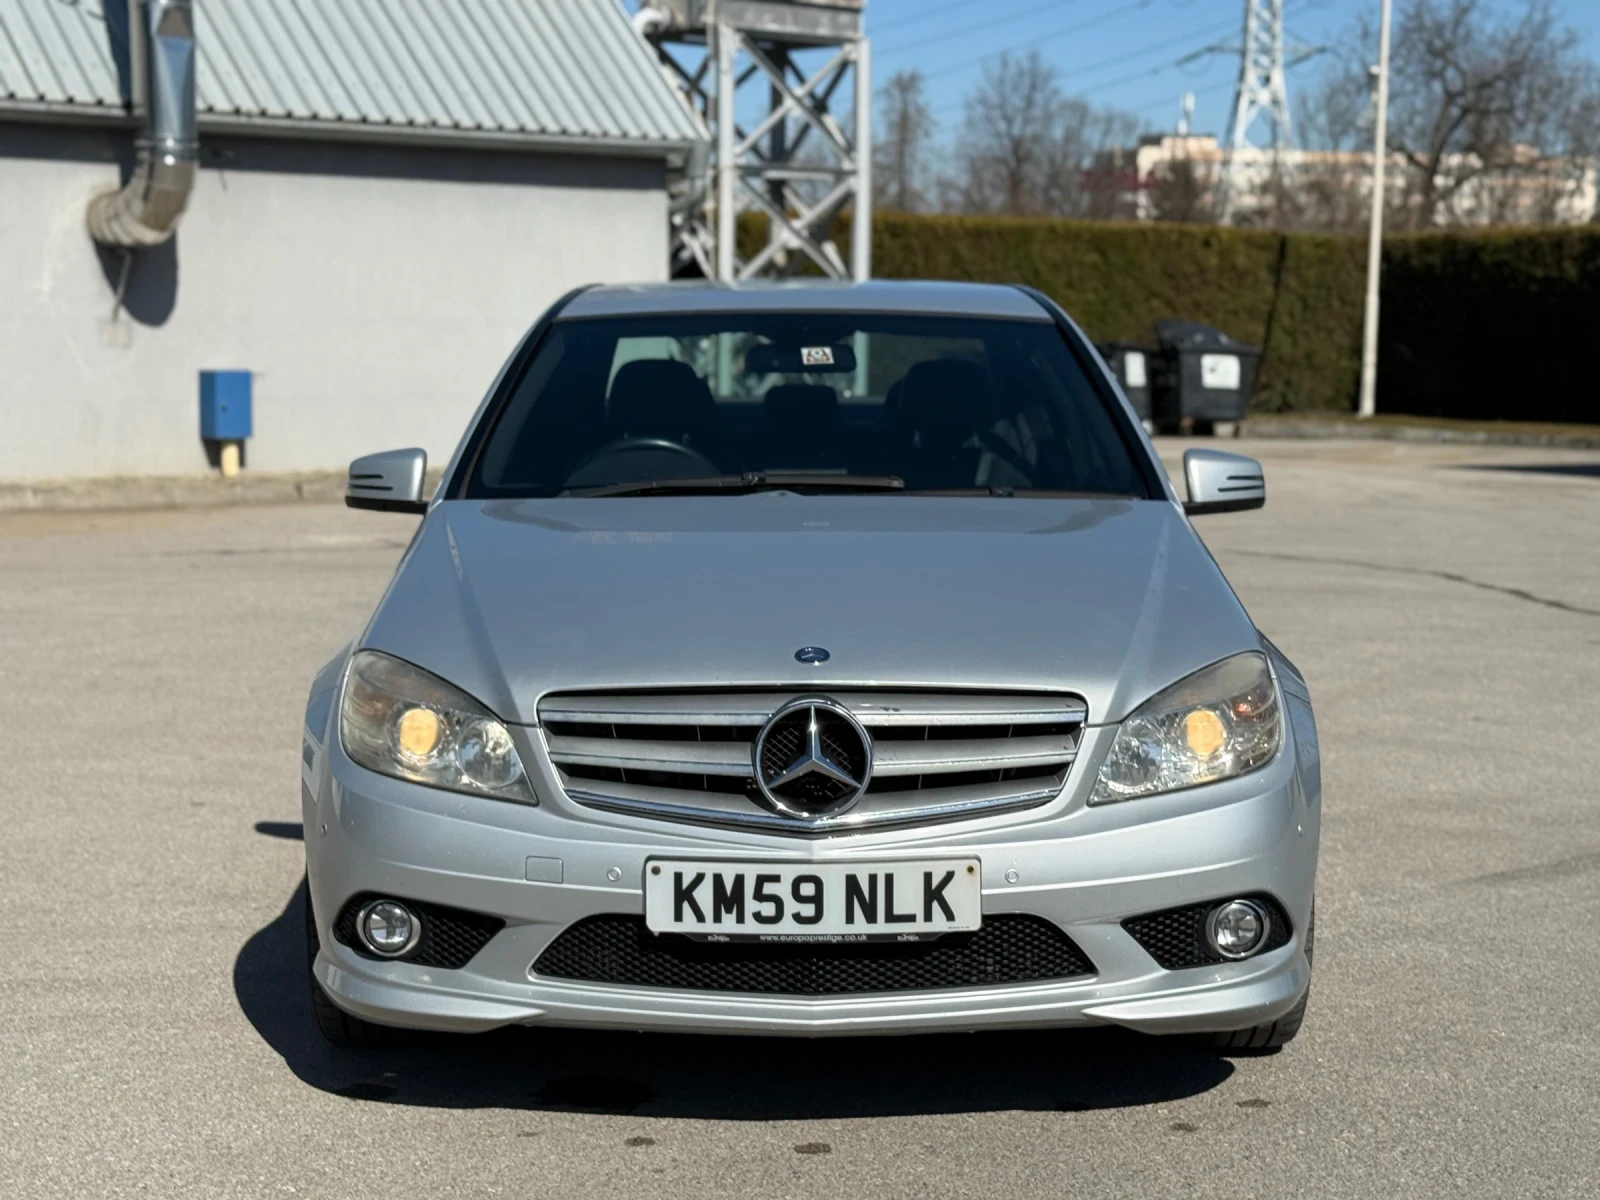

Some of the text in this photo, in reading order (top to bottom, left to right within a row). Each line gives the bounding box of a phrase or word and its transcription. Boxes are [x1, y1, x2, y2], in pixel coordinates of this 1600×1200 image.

[673, 870, 956, 925] KM59 NLK
[759, 933, 868, 943] www.europaprestige.co.uk
